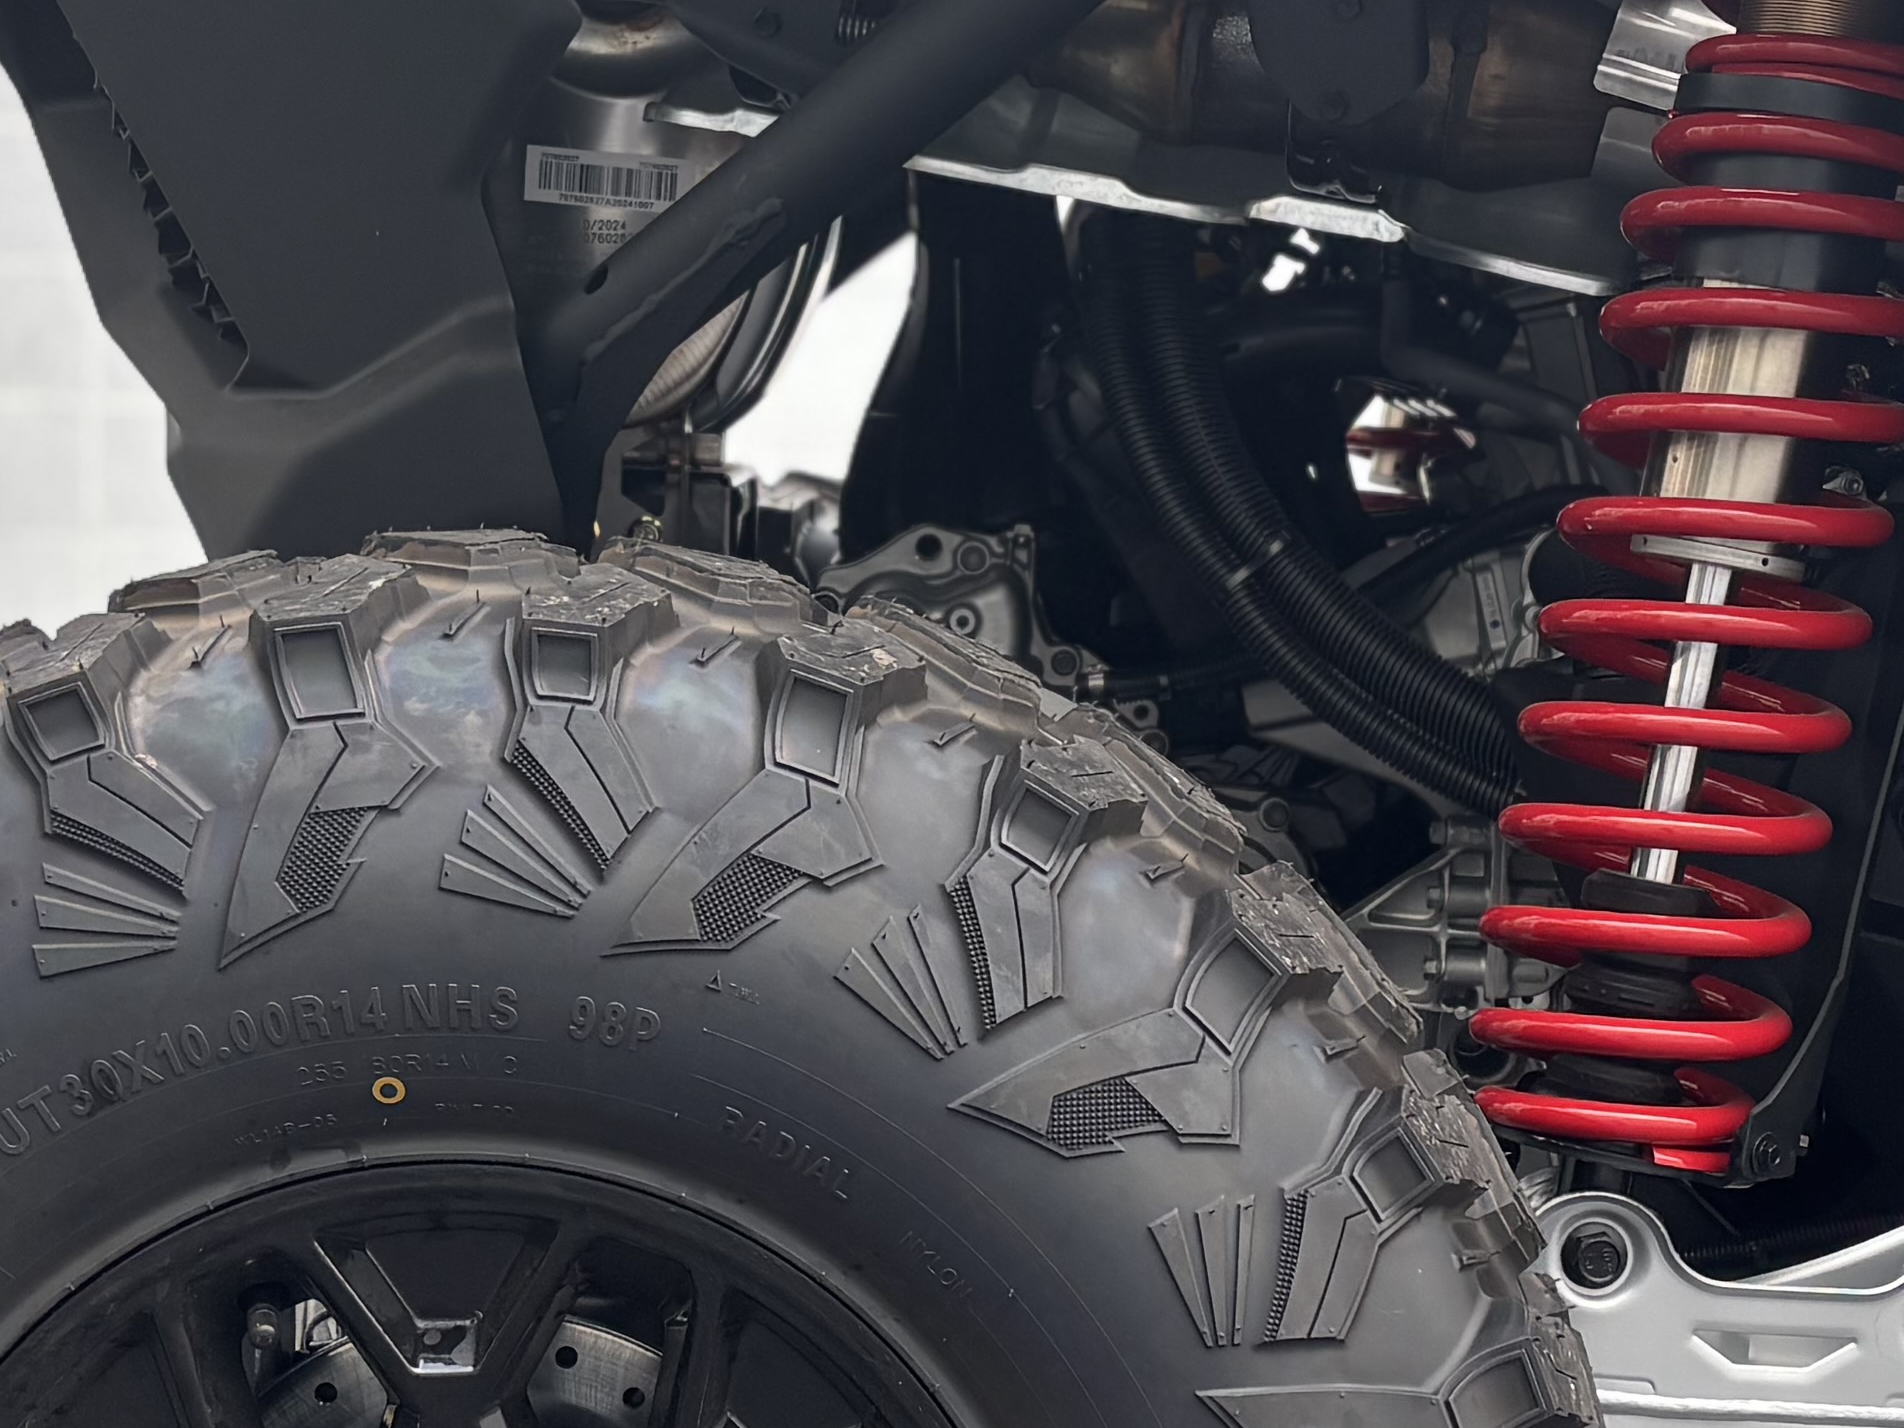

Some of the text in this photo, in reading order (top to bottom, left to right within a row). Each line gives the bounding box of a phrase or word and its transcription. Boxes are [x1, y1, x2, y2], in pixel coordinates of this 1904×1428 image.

[402, 983, 519, 1031] NHS
[567, 995, 662, 1052] 98P
[716, 1104, 851, 1200] RADIAL
[898, 1229, 974, 1301] NYLON
